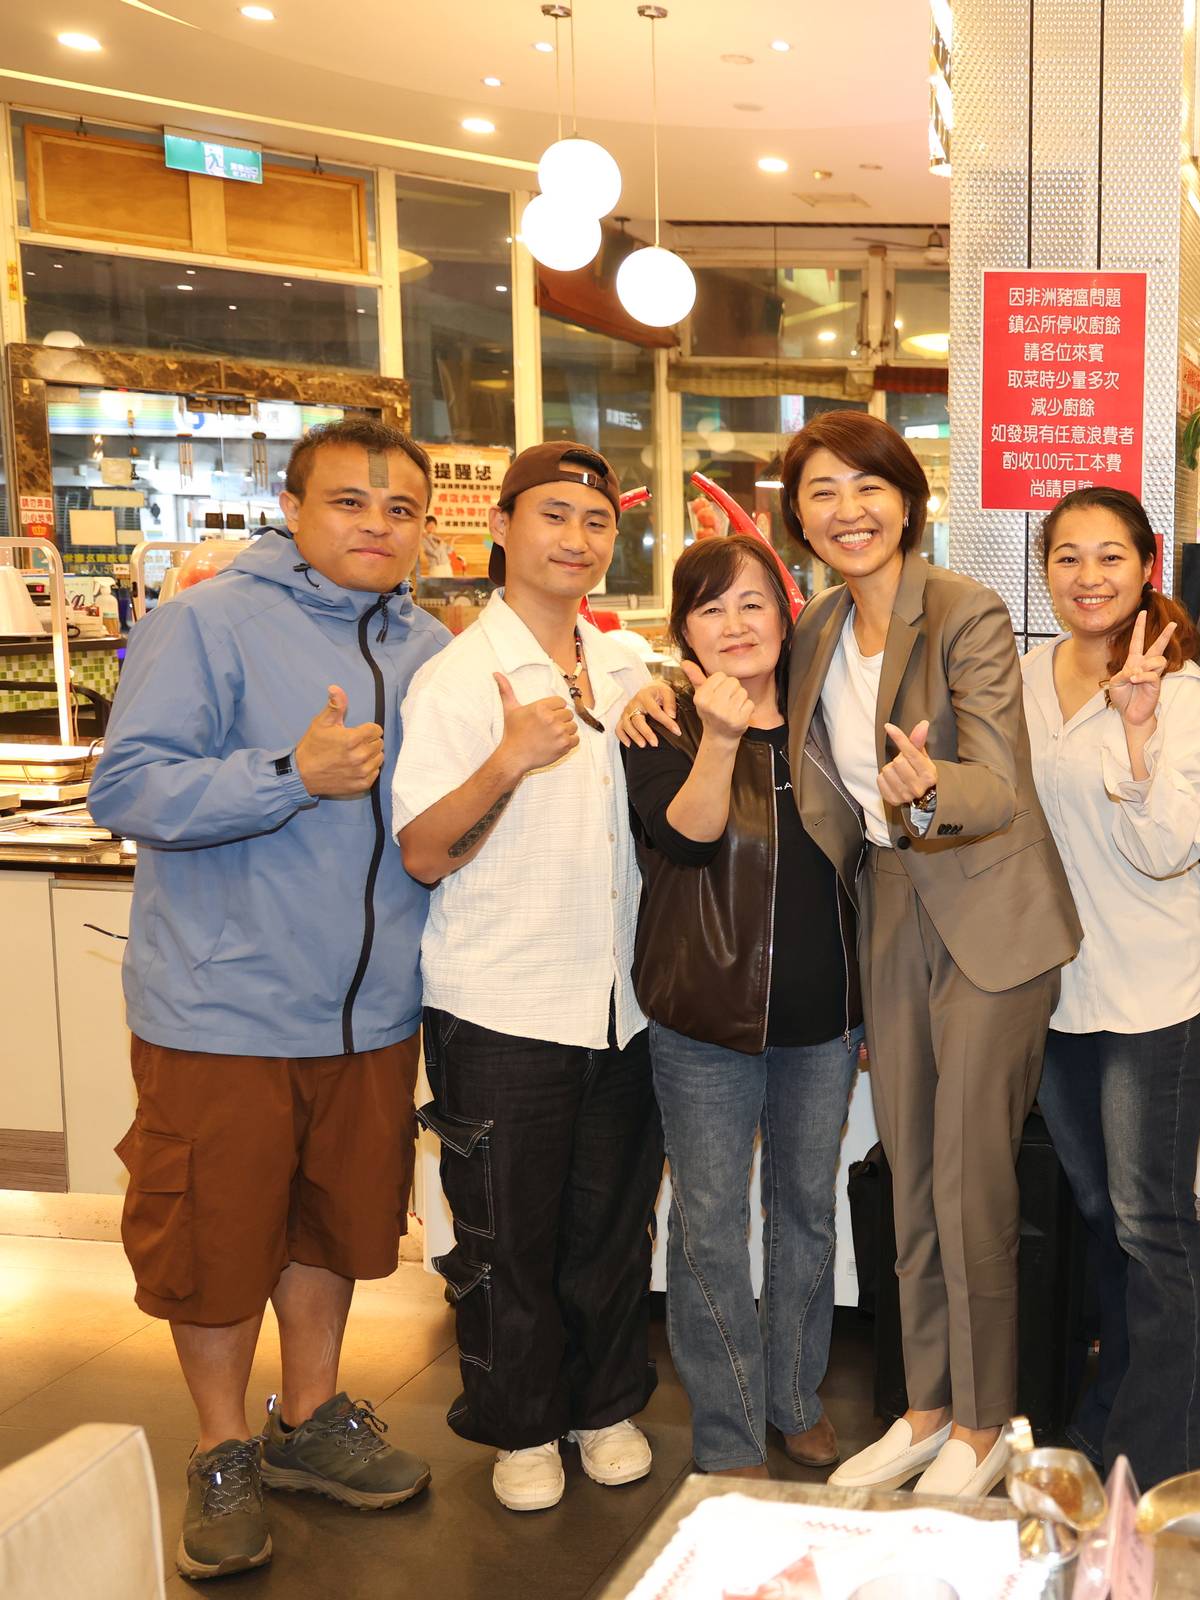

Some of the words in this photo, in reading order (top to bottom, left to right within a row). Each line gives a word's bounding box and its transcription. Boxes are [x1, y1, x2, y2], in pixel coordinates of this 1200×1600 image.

[1009, 287, 1121, 307] 因非洲豬瘟問題
[1008, 315, 1121, 335] 鎮公所停收廚餘
[1024, 343, 1104, 362] 請各位來賓
[1008, 370, 1120, 390] 取菜時少量多次
[1031, 398, 1095, 417] 減少廚餘
[991, 424, 1134, 445] 如發現有任意浪費者
[1002, 452, 1122, 472] 酌收100元工本費
